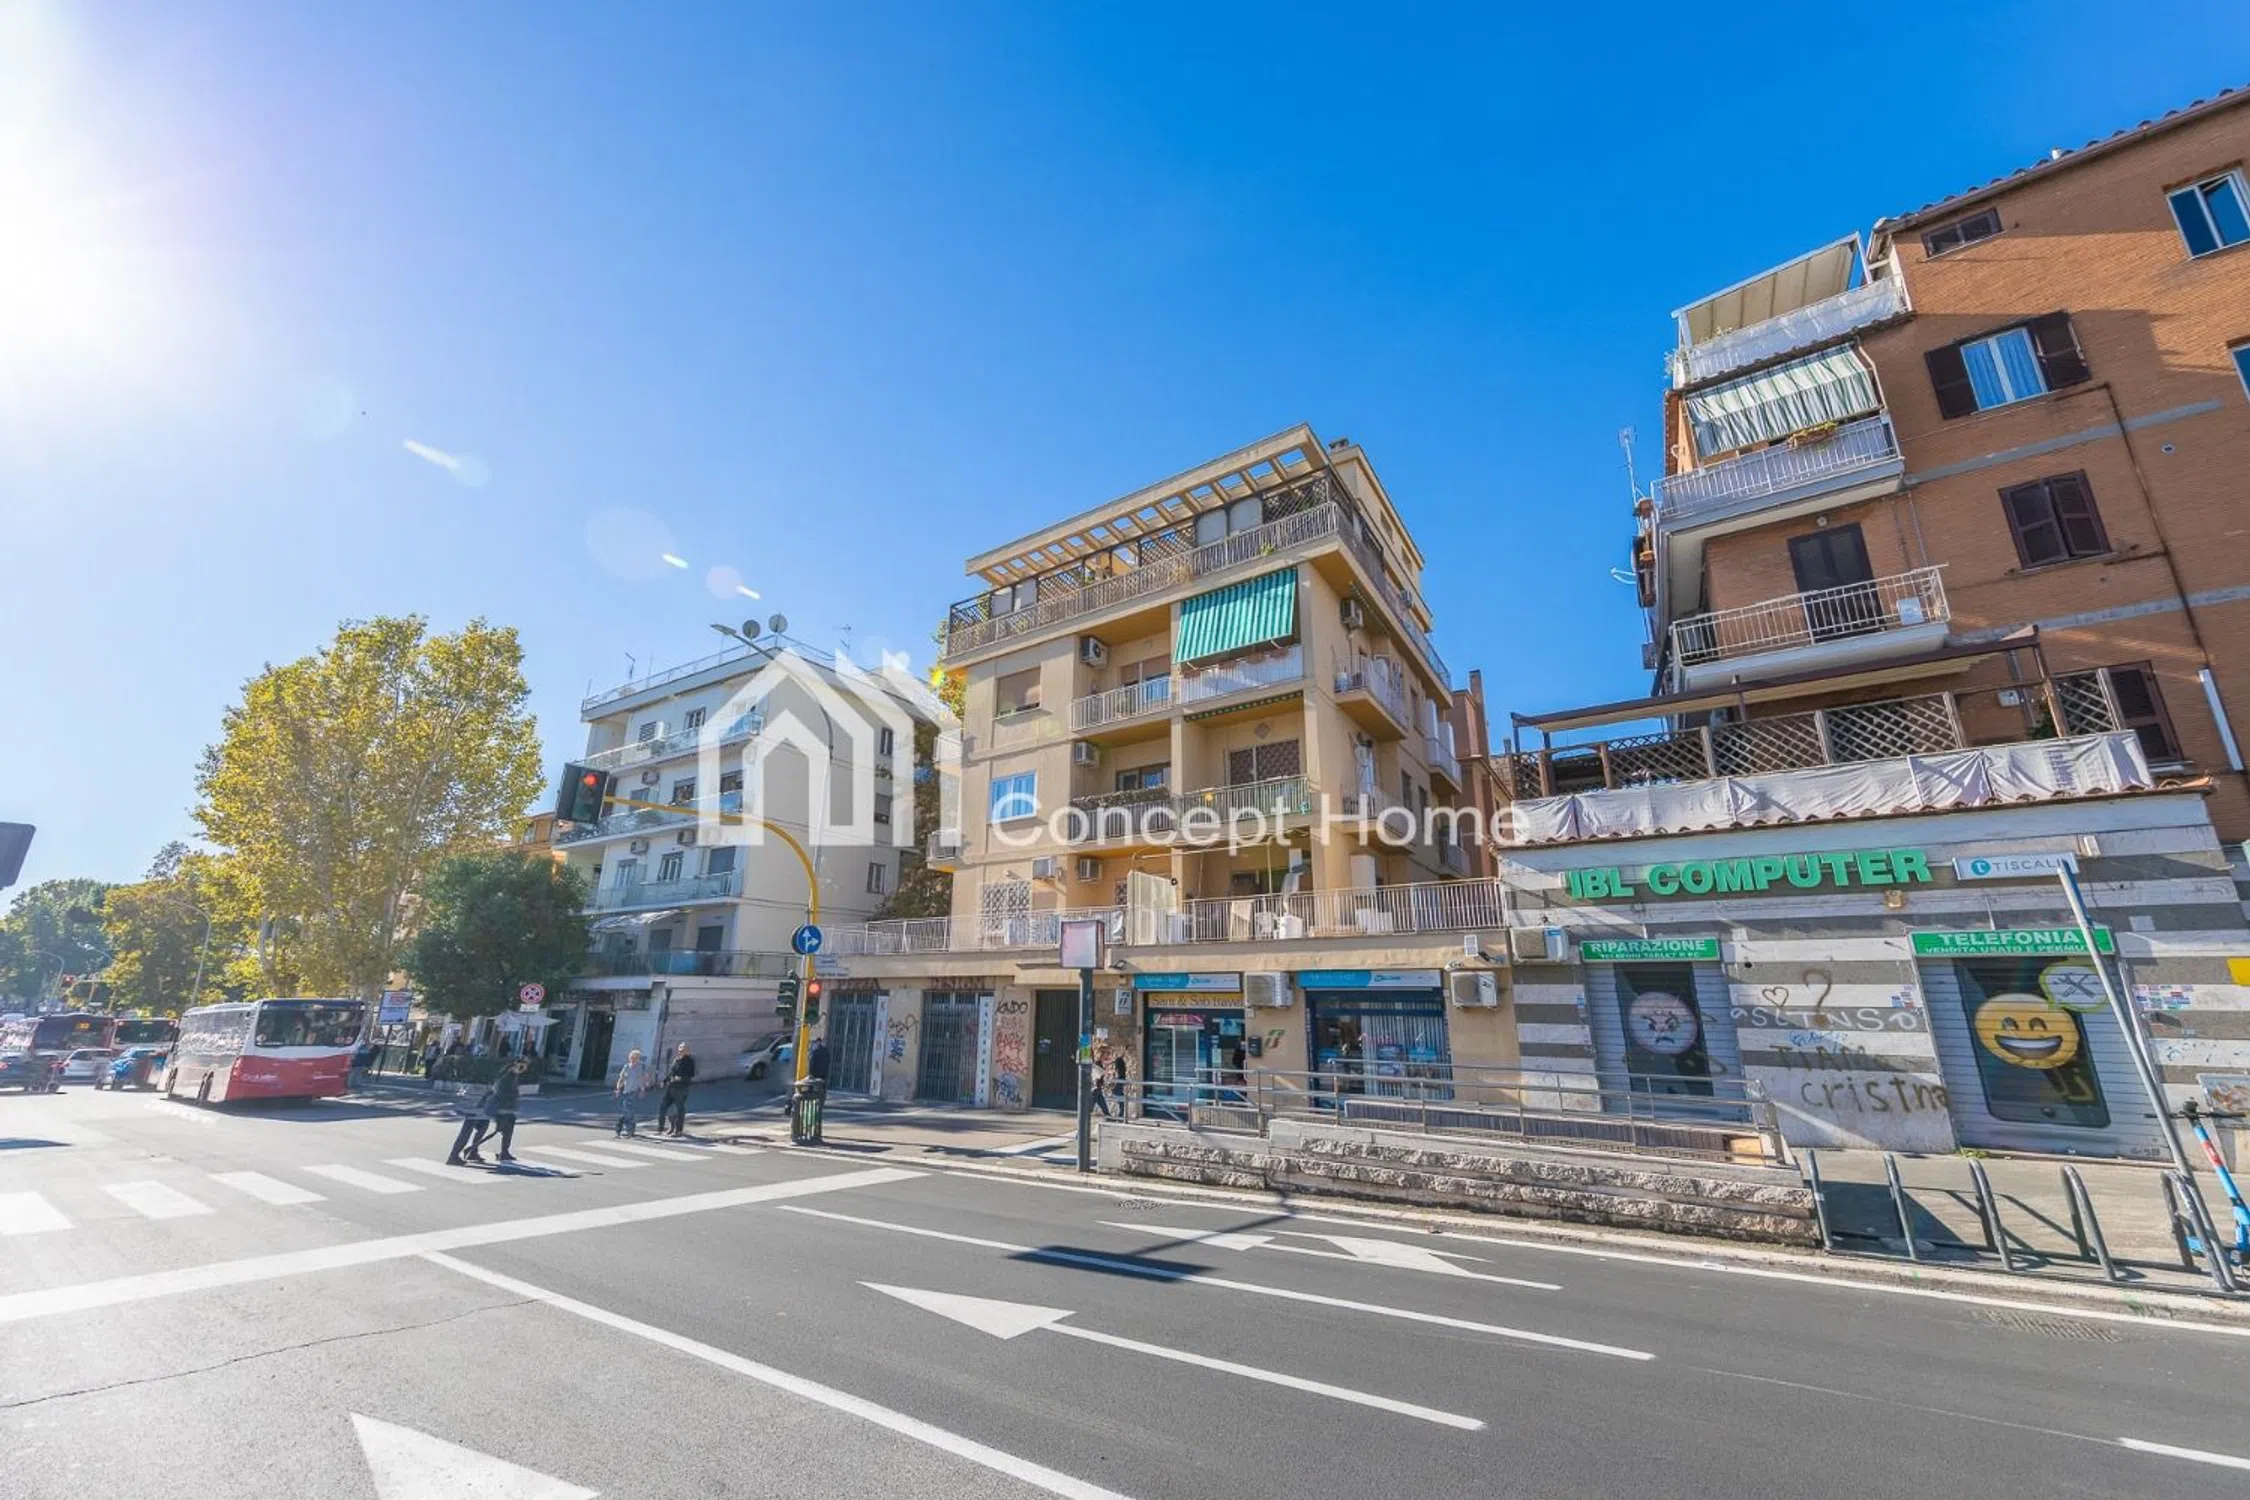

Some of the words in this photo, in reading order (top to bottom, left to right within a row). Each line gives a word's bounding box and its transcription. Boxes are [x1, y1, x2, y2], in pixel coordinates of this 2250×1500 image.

[1647, 848, 1933, 896] COMPUTER
[1939, 930, 2080, 946] TELEFONIA
[1591, 940, 1706, 953] RIPARAZIONE
